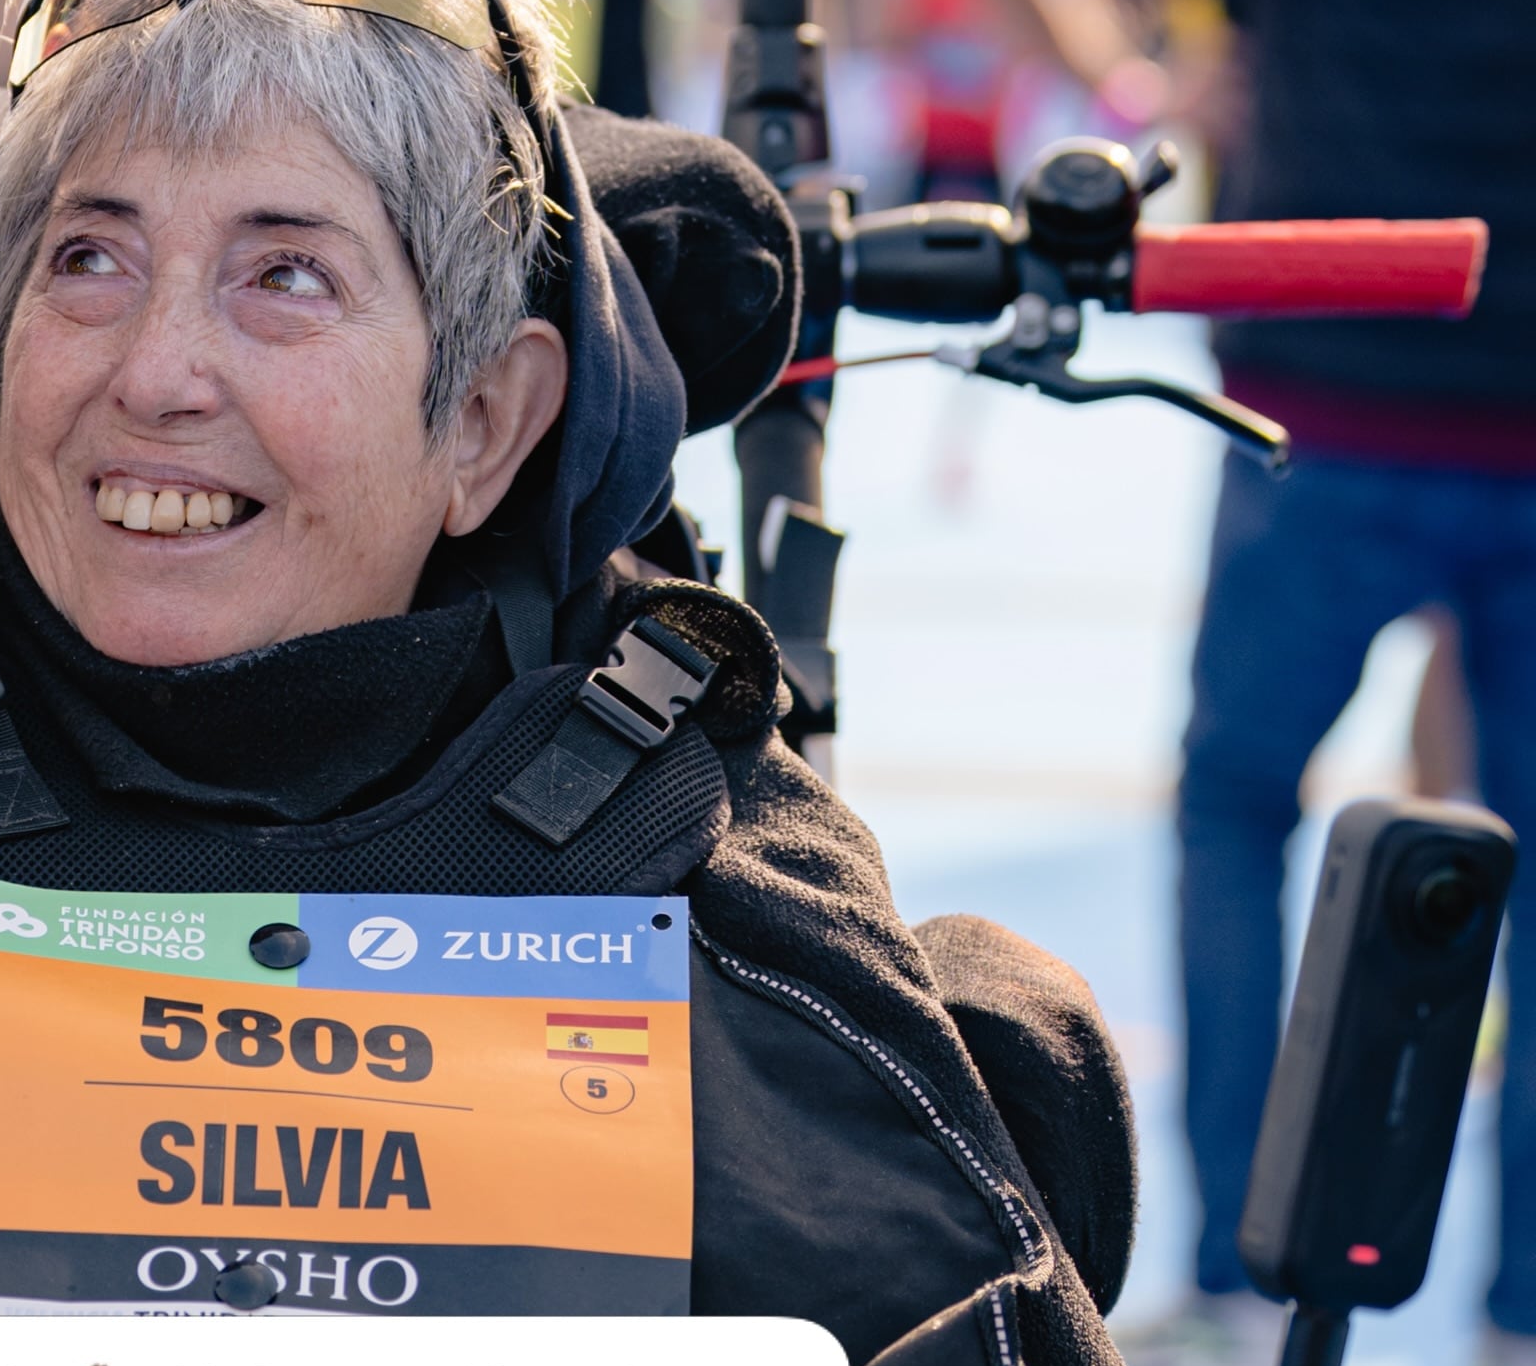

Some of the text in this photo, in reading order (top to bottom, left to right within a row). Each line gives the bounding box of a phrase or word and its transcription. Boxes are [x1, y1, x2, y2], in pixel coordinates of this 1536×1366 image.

[60, 906, 206, 925] FUNDACIÓN
[58, 917, 206, 945] TRINIDAD
[58, 933, 206, 962] ALFONSO
[140, 995, 435, 1084] 5809
[585, 1077, 609, 1102] 5
[136, 1119, 432, 1212] SILVIA
